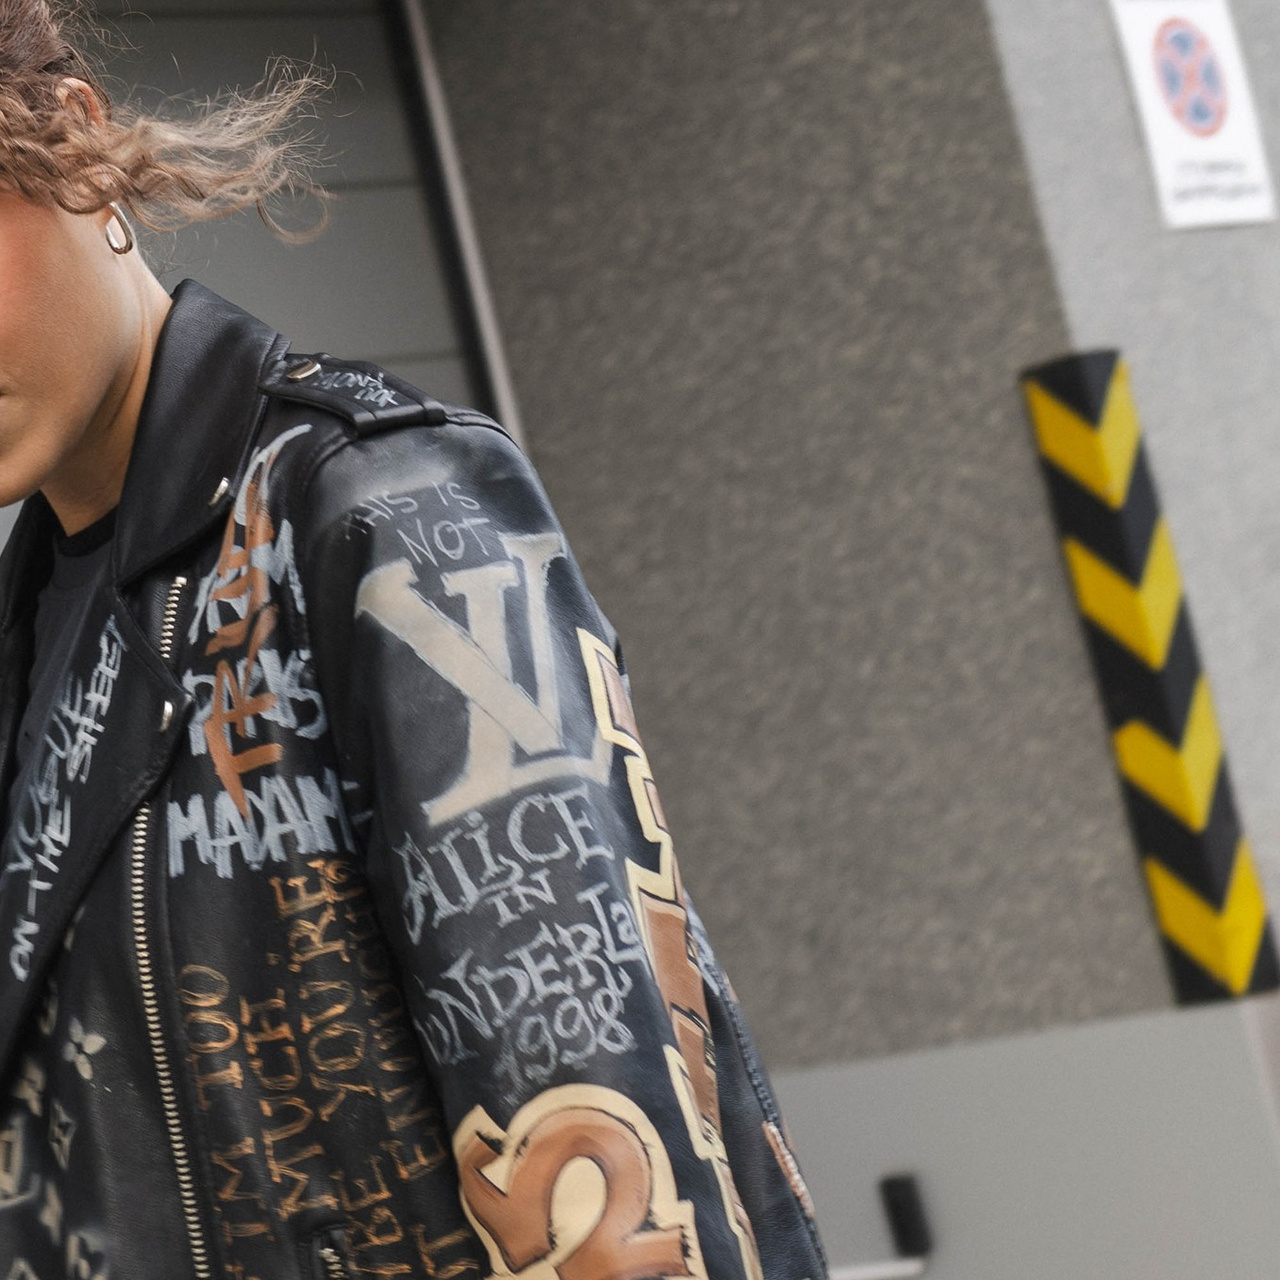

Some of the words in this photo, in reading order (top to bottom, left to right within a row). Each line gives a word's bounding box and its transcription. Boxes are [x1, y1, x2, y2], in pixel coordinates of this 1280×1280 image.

[431, 481, 481, 512] IS
[396, 516, 491, 568] NOT
[178, 963, 244, 1111] TOO
